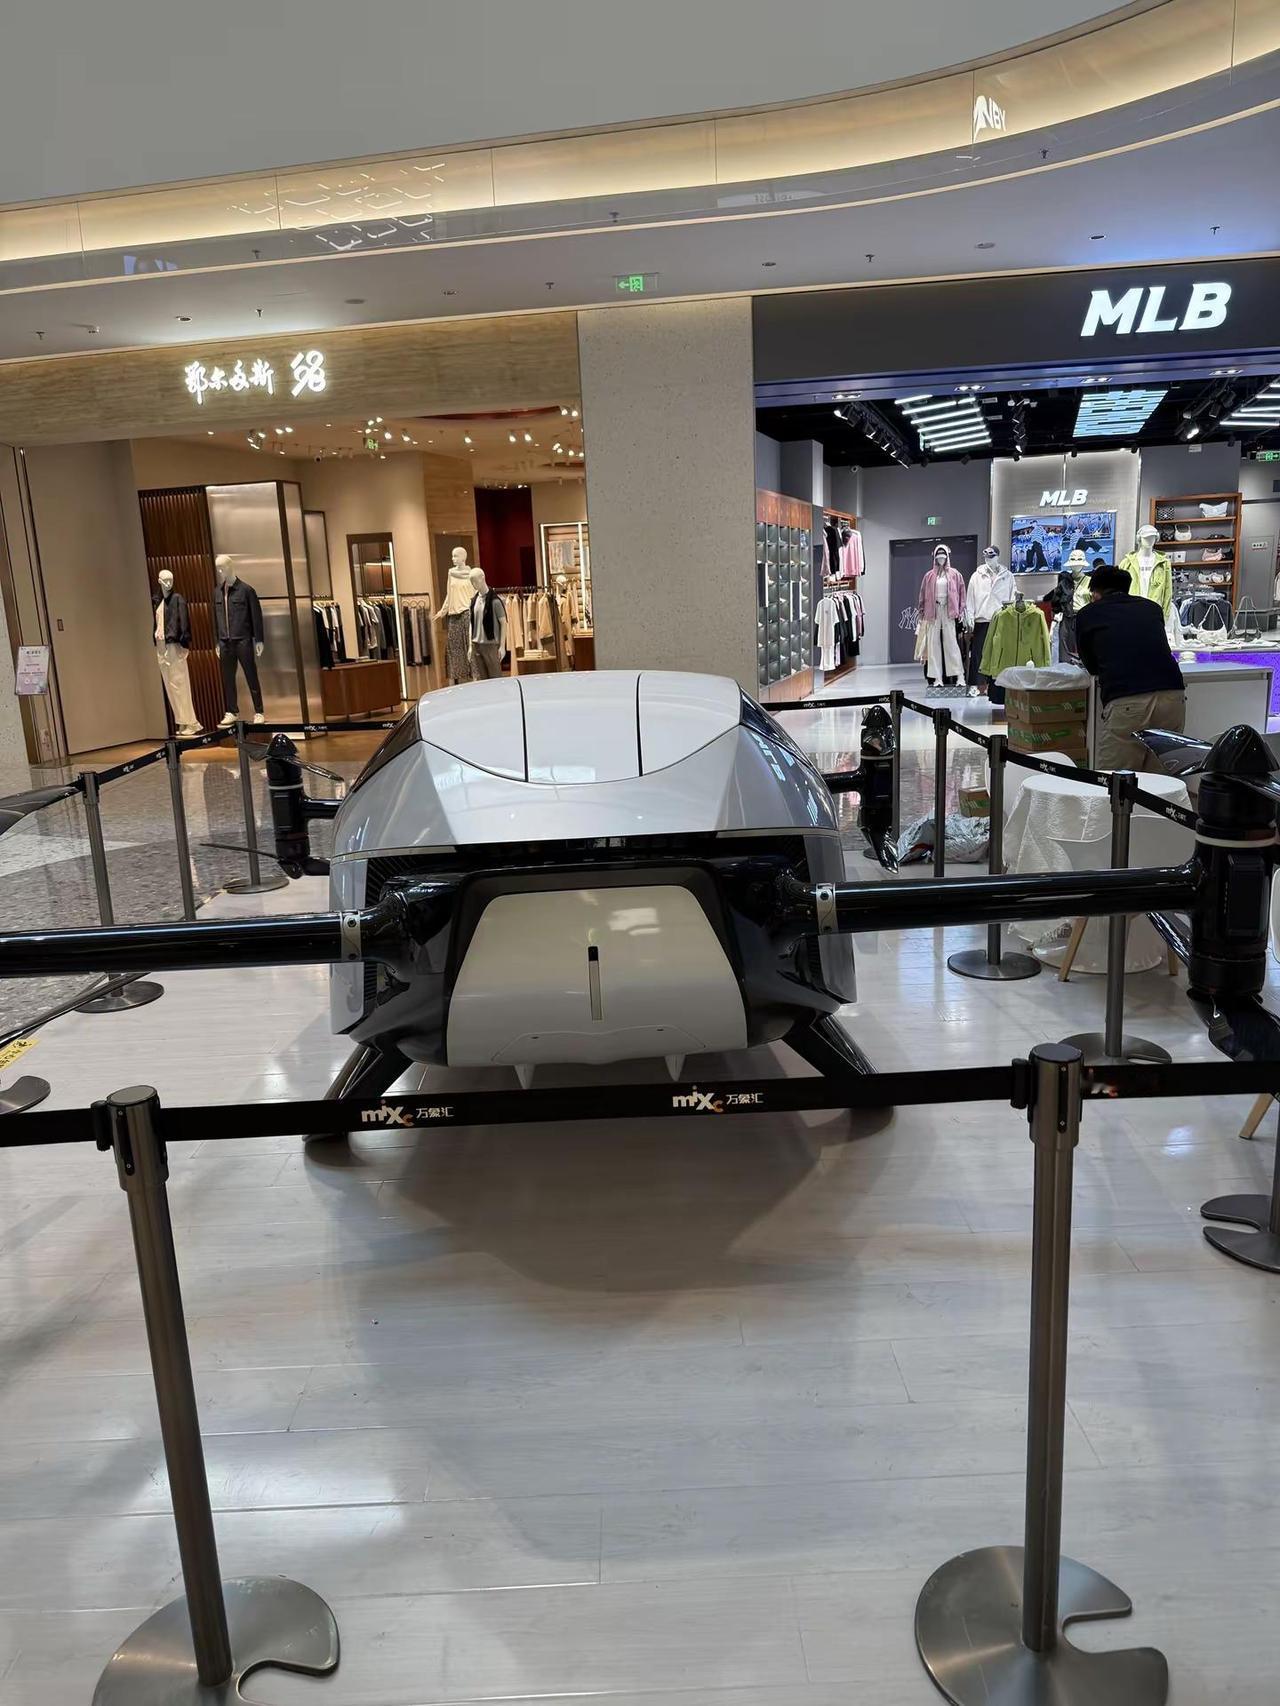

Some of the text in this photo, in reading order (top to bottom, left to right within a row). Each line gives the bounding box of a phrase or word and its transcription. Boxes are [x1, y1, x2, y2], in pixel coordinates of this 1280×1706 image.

[1080, 282, 1232, 337] MLB
[184, 358, 274, 405] 鄂尔多斯
[1039, 489, 1088, 507] MLB
[725, 1092, 764, 1105] 万象汇
[415, 1106, 455, 1118] 万象汇
